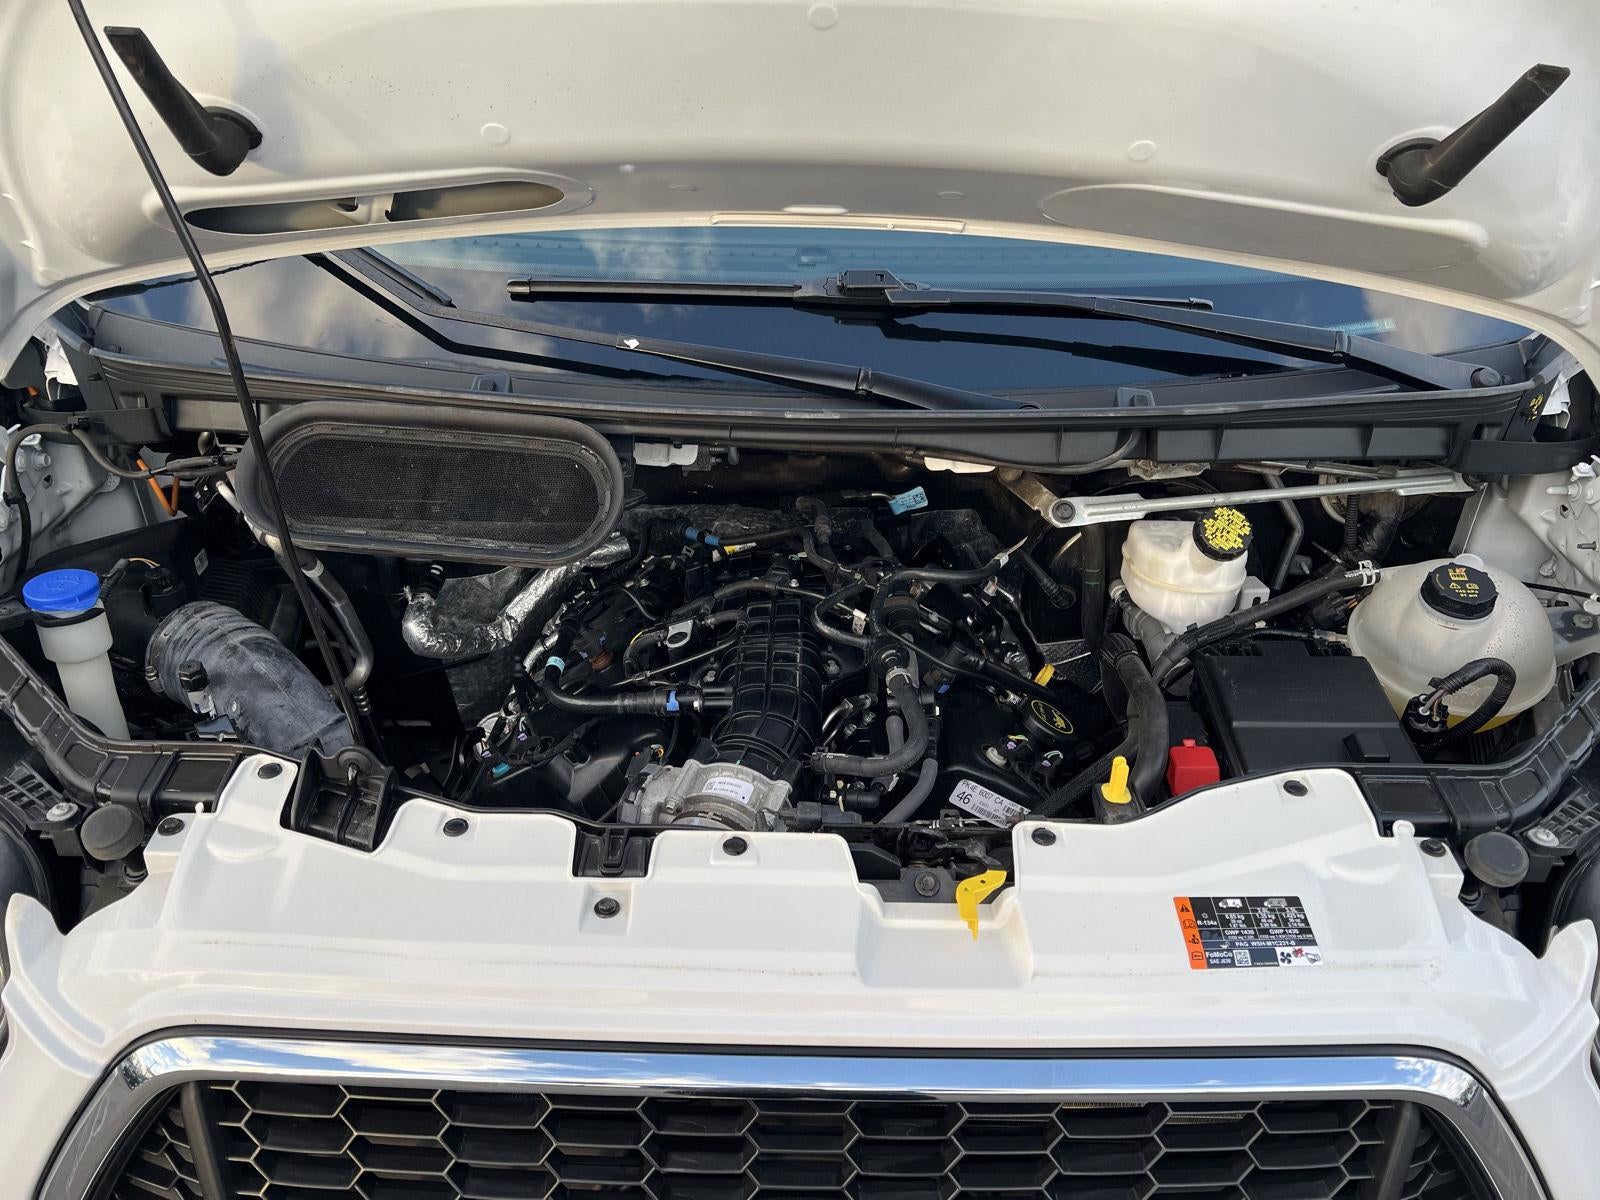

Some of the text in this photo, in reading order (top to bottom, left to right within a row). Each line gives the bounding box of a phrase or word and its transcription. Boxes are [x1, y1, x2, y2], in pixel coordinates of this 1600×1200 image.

[956, 791, 973, 805] 46
[962, 780, 978, 793] PK4E
[978, 789, 994, 800] 6007
[994, 796, 1004, 806] CA
[1205, 950, 1233, 958] FoMoCo
